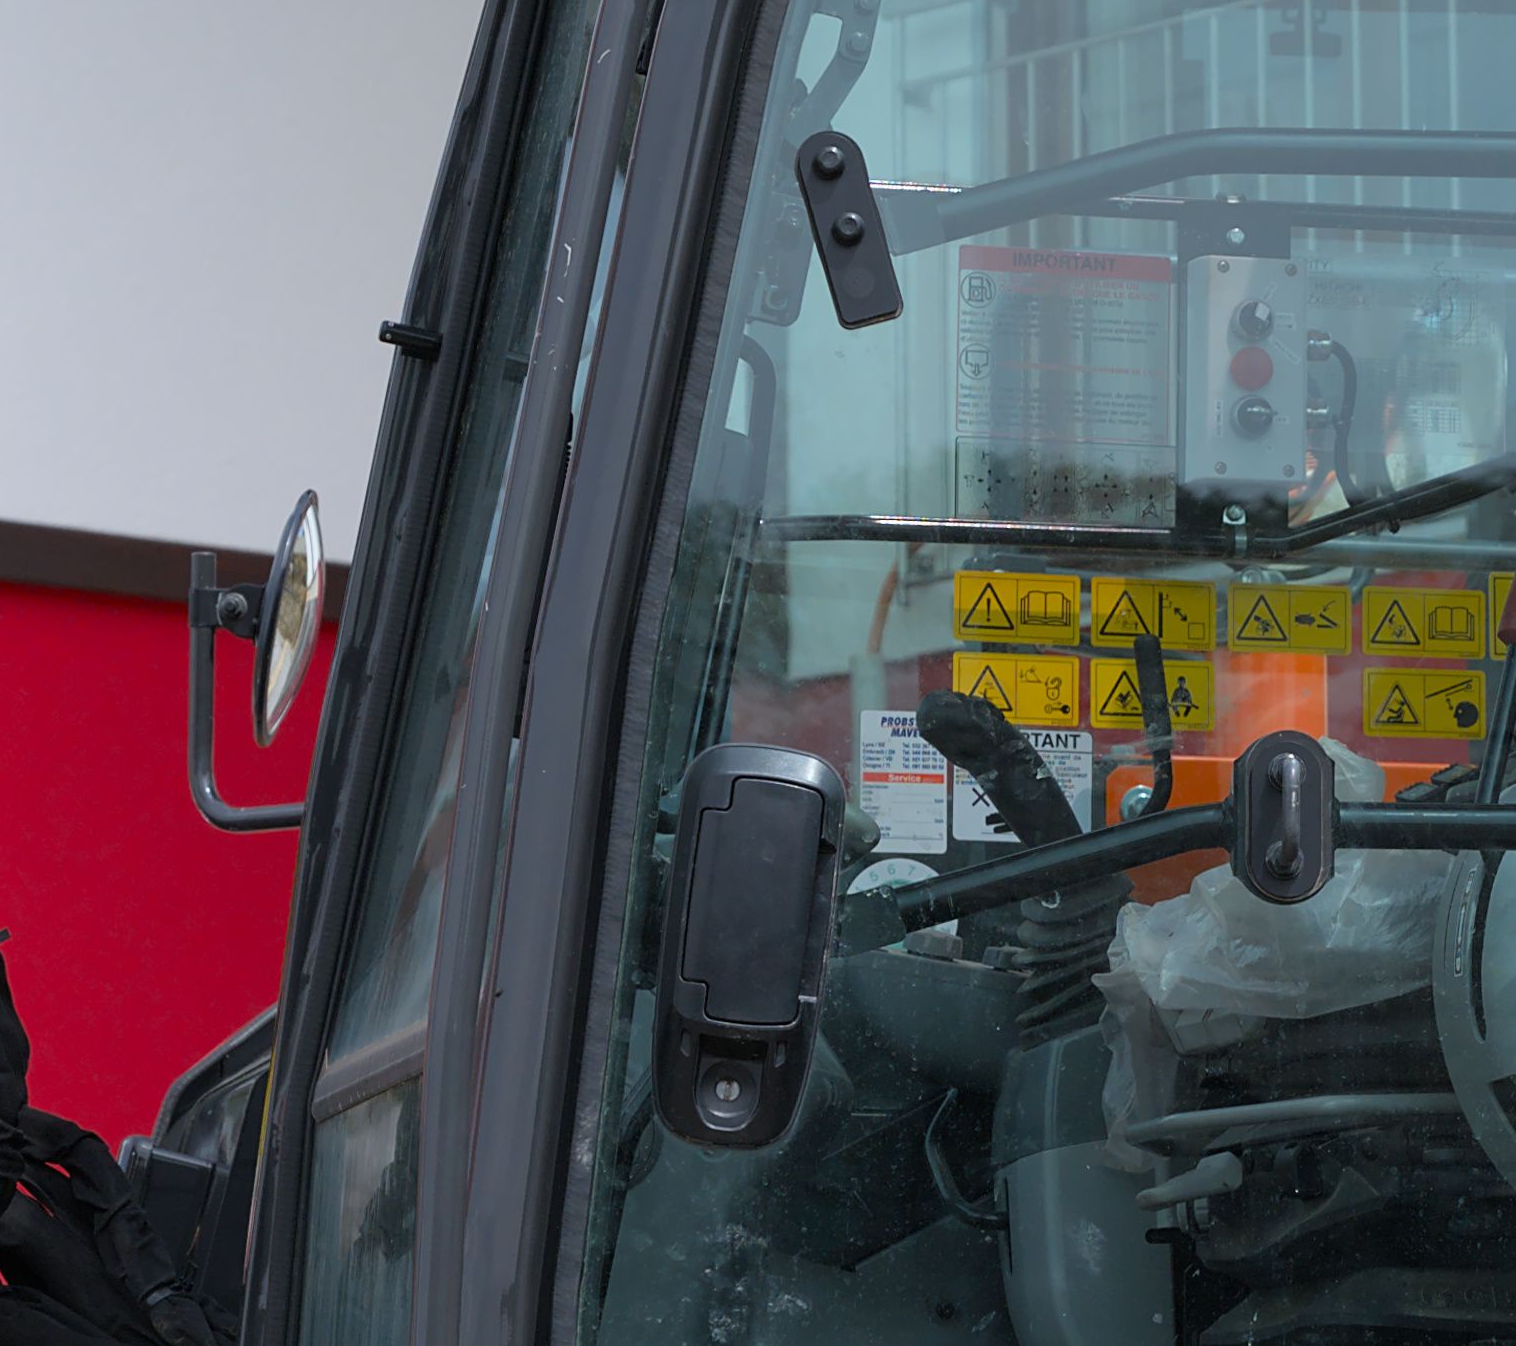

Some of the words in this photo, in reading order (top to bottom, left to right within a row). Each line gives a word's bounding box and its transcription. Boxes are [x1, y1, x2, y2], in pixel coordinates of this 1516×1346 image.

[1012, 252, 1117, 272] IMPORTANT
[888, 773, 922, 783] Service
[870, 870, 879, 882] 5
[887, 863, 896, 875] 6
[908, 864, 916, 876] 7
